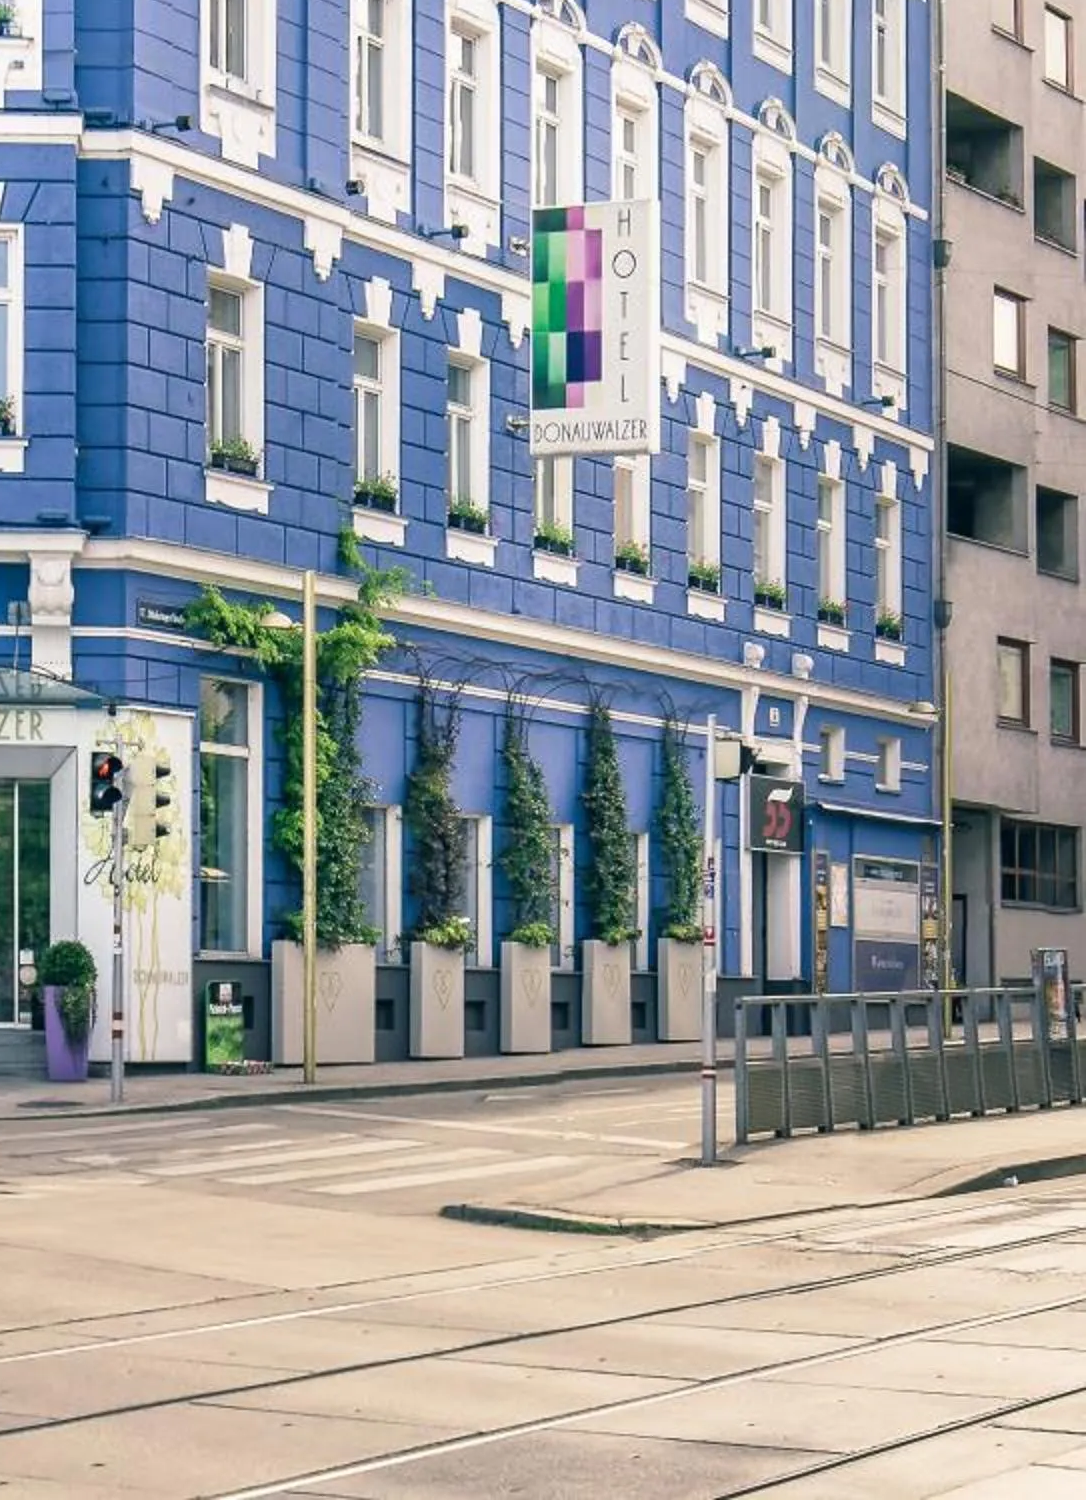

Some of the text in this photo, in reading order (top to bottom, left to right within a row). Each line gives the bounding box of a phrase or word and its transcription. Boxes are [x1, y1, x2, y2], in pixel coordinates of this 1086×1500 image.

[612, 208, 637, 403] HOTEL
[533, 419, 648, 444] DONAUWALZER
[84, 823, 162, 886] Hotel
